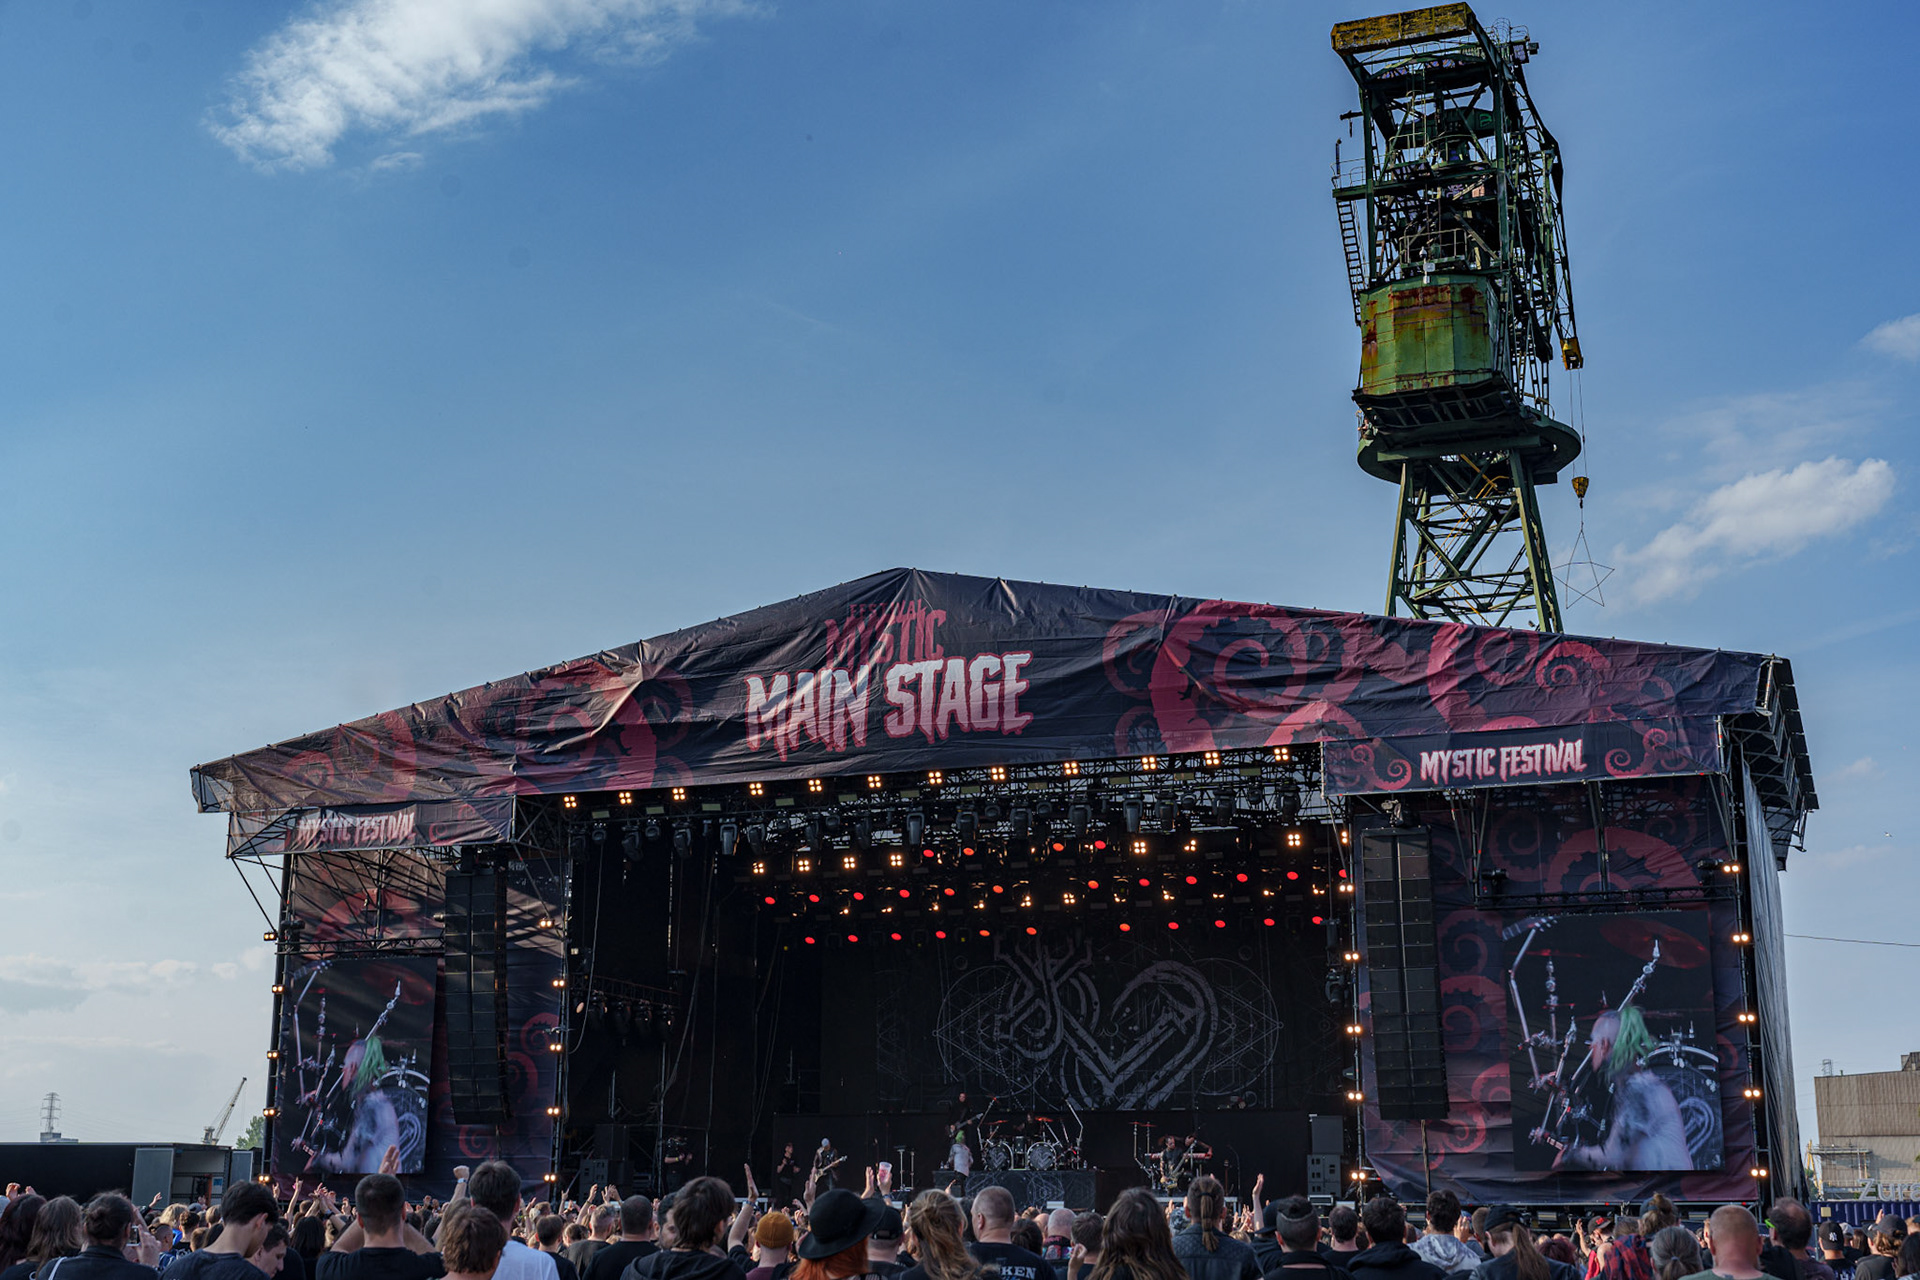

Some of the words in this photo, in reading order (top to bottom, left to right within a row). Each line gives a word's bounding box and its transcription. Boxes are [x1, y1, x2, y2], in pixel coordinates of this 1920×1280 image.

[824, 609, 946, 668] MYSTIC
[745, 664, 871, 762] MAIN
[884, 651, 1033, 744] STAGE
[1420, 747, 1496, 785] MYSTIC
[1500, 737, 1587, 782] FESTIVAL
[298, 817, 352, 845] MYSTIC
[354, 811, 416, 847] FESTIVAL
[1001, 1266, 1037, 1280] KEN
